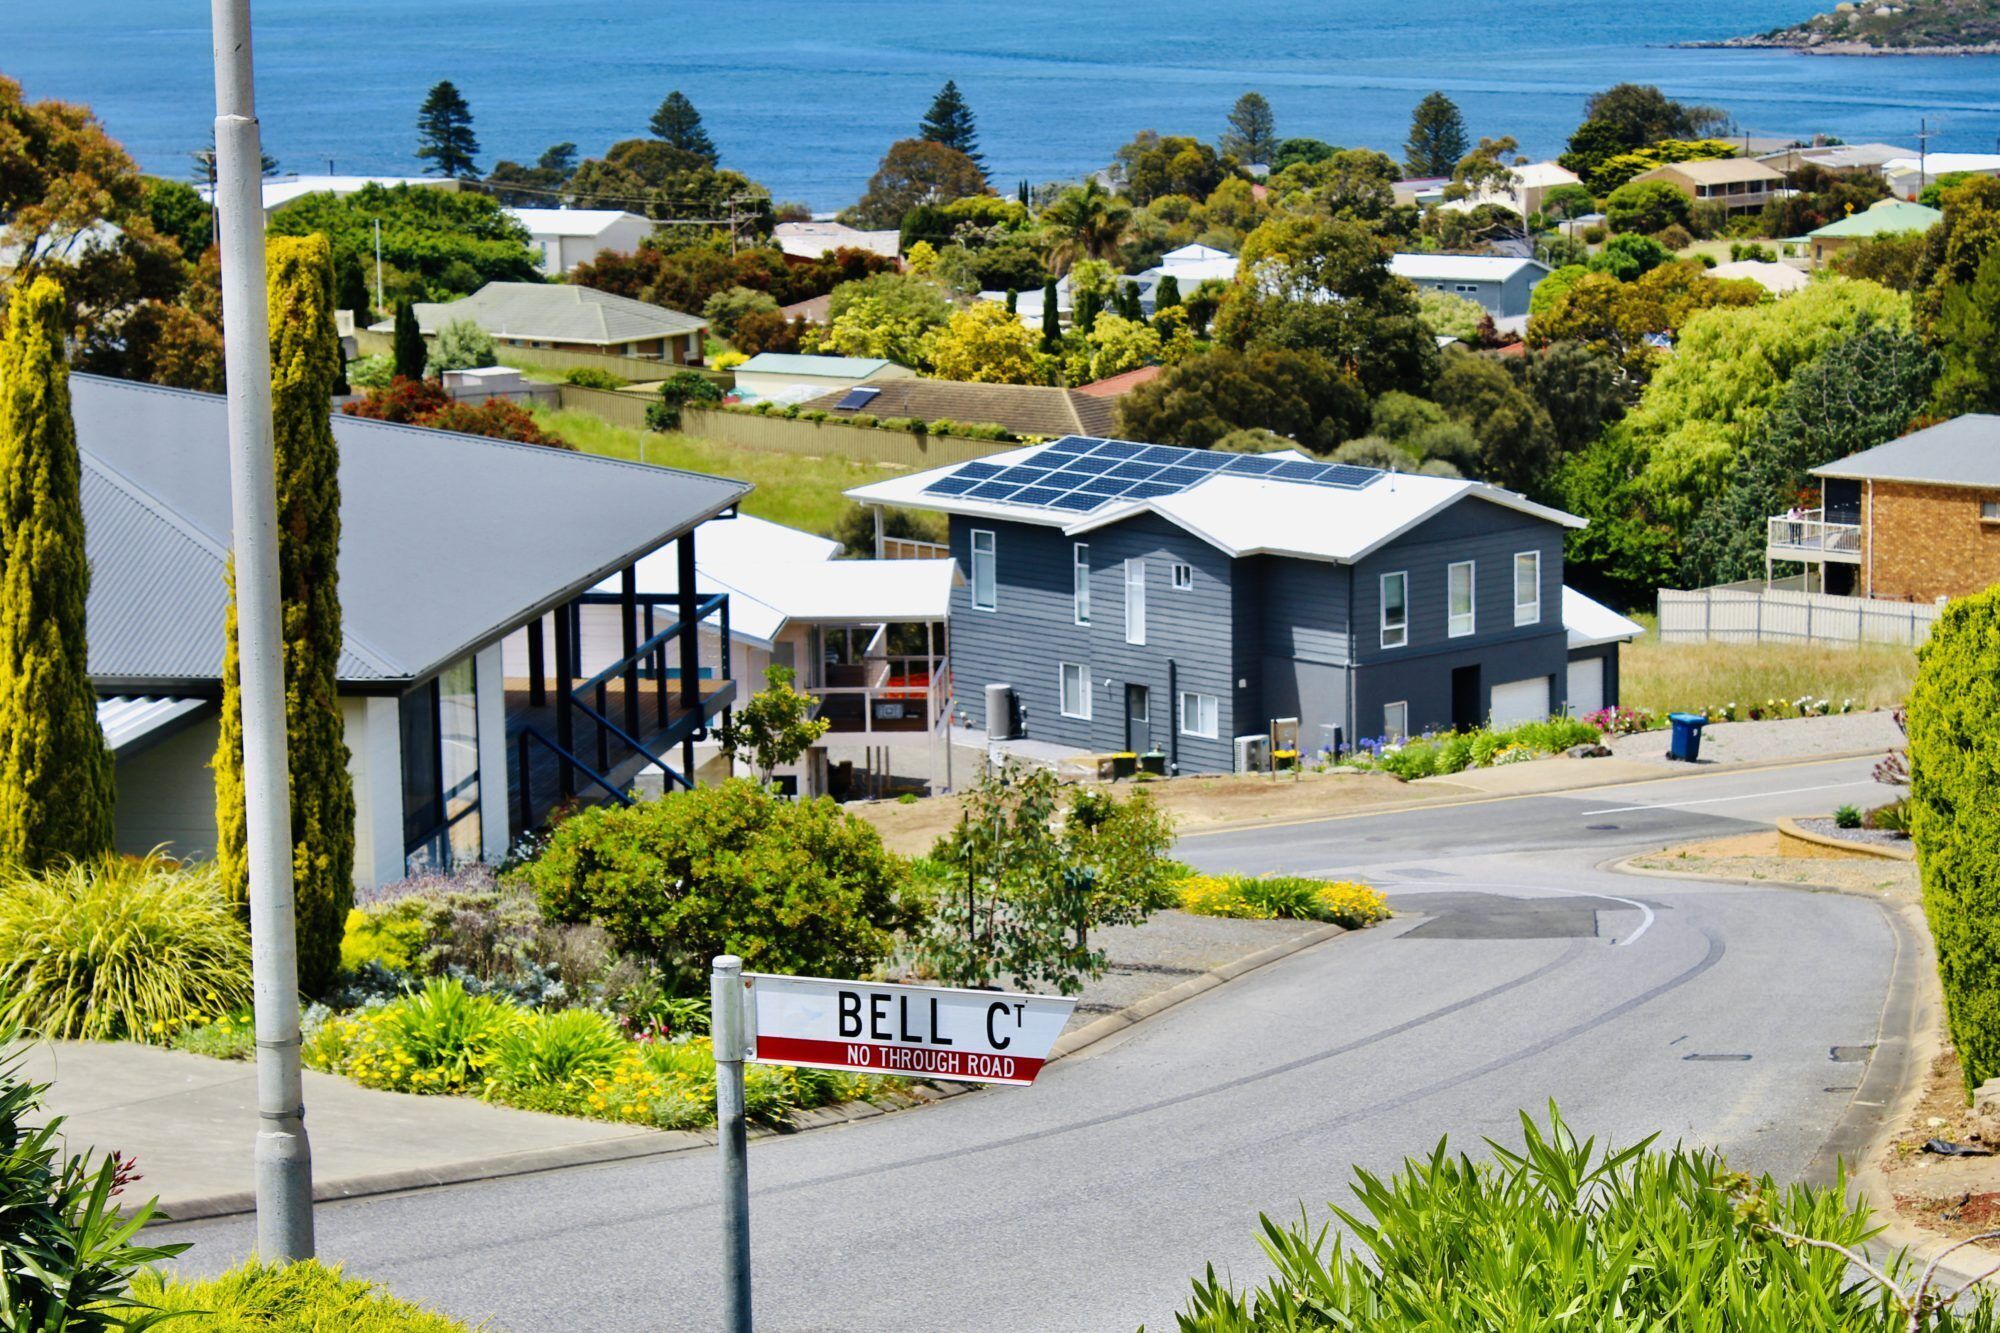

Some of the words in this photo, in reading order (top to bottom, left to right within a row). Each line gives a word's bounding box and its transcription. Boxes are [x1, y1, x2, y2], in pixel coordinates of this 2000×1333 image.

[839, 991, 952, 1045] BELL
[847, 1045, 870, 1066] NO
[879, 1047, 960, 1073] THROUGH
[967, 1053, 1015, 1078] ROAD
